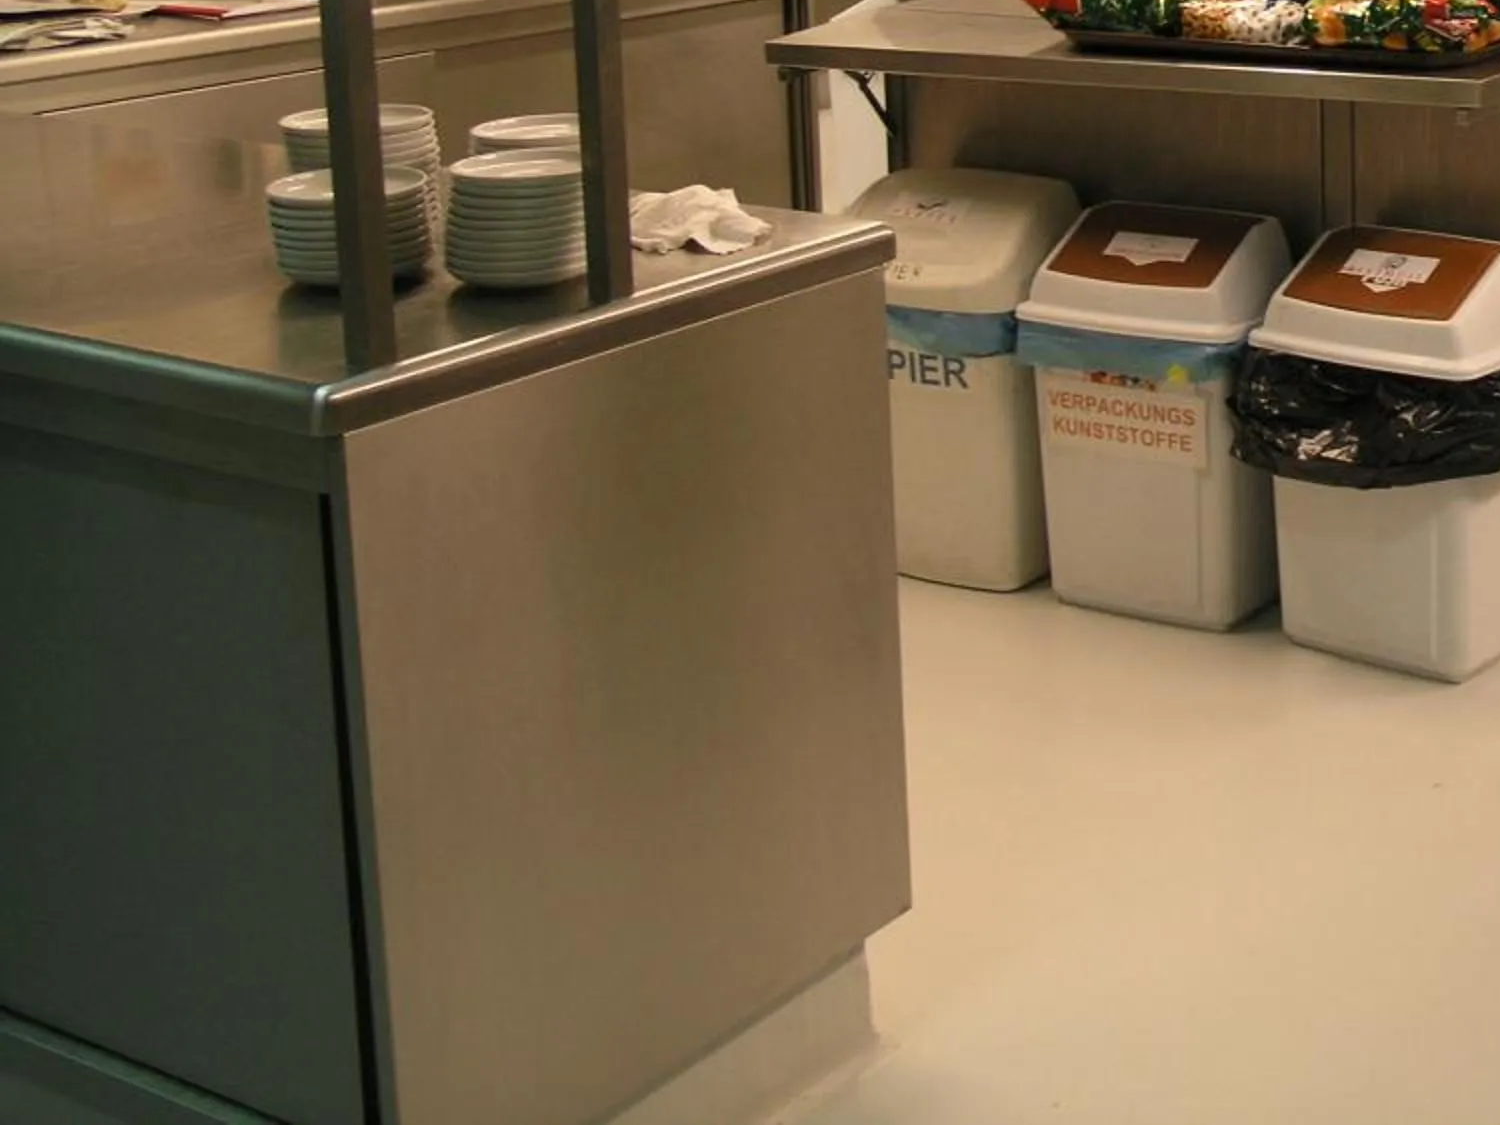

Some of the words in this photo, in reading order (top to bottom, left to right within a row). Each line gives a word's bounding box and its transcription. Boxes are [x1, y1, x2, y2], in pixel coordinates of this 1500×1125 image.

[887, 349, 968, 389] PIER
[1048, 391, 1196, 426] VERPACKUNGS
[1053, 416, 1194, 452] KUNSTSTOFFE
